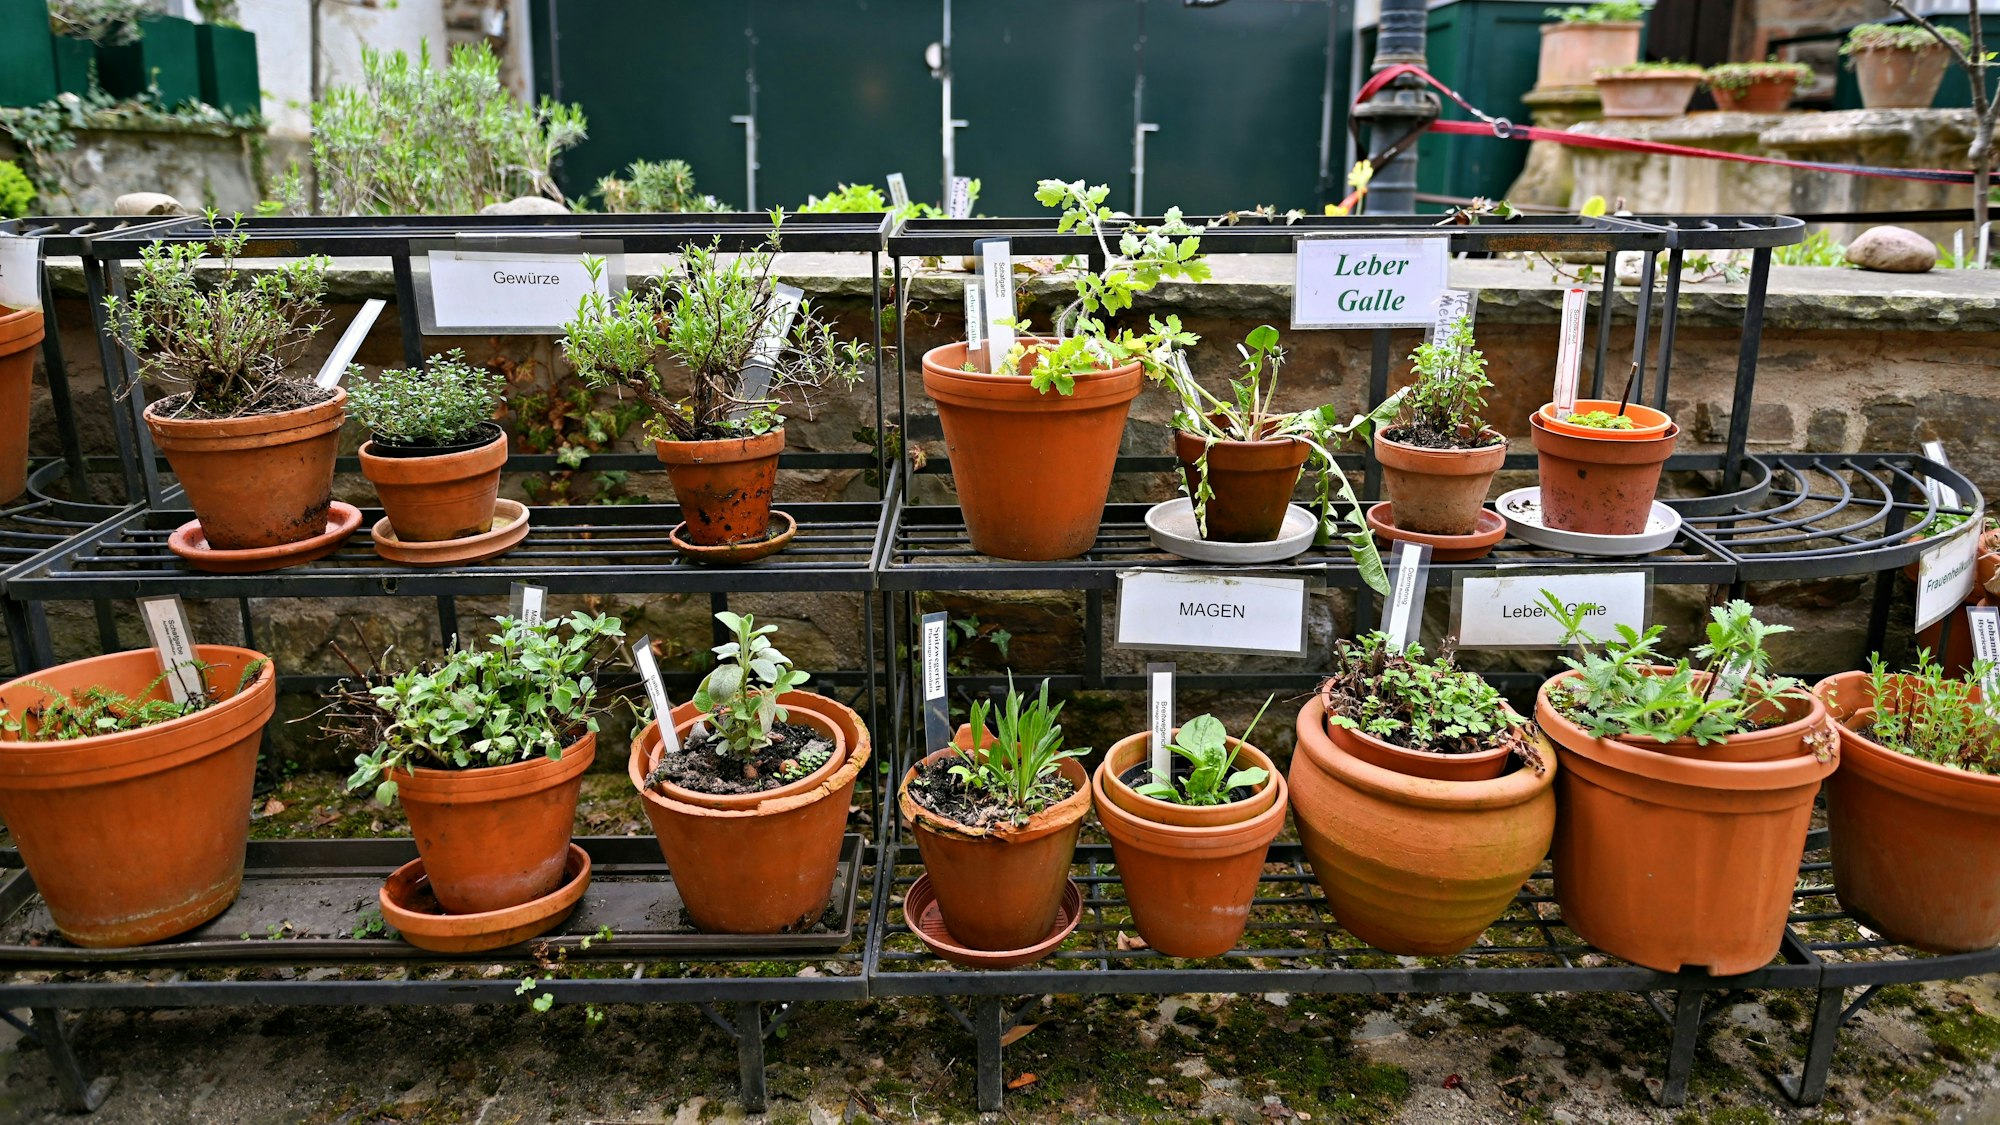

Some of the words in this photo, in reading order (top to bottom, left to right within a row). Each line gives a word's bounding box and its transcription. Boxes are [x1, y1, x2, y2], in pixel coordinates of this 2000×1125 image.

[493, 271, 561, 285] Gewürze
[998, 262, 1006, 298] Schafgarbe
[1334, 253, 1410, 277] Leber
[1337, 289, 1406, 312] Galle
[970, 321, 978, 343] Galle
[1401, 567, 1415, 606] Odermennig
[1179, 602, 1245, 618] MAGEN
[1503, 605, 1550, 618] Leber
[168, 619, 183, 656] Schafgarbe
[1977, 619, 1988, 657] Hypericum
[933, 627, 941, 691] Spitzwegerich
[1160, 701, 1168, 749] Breitwegerich
